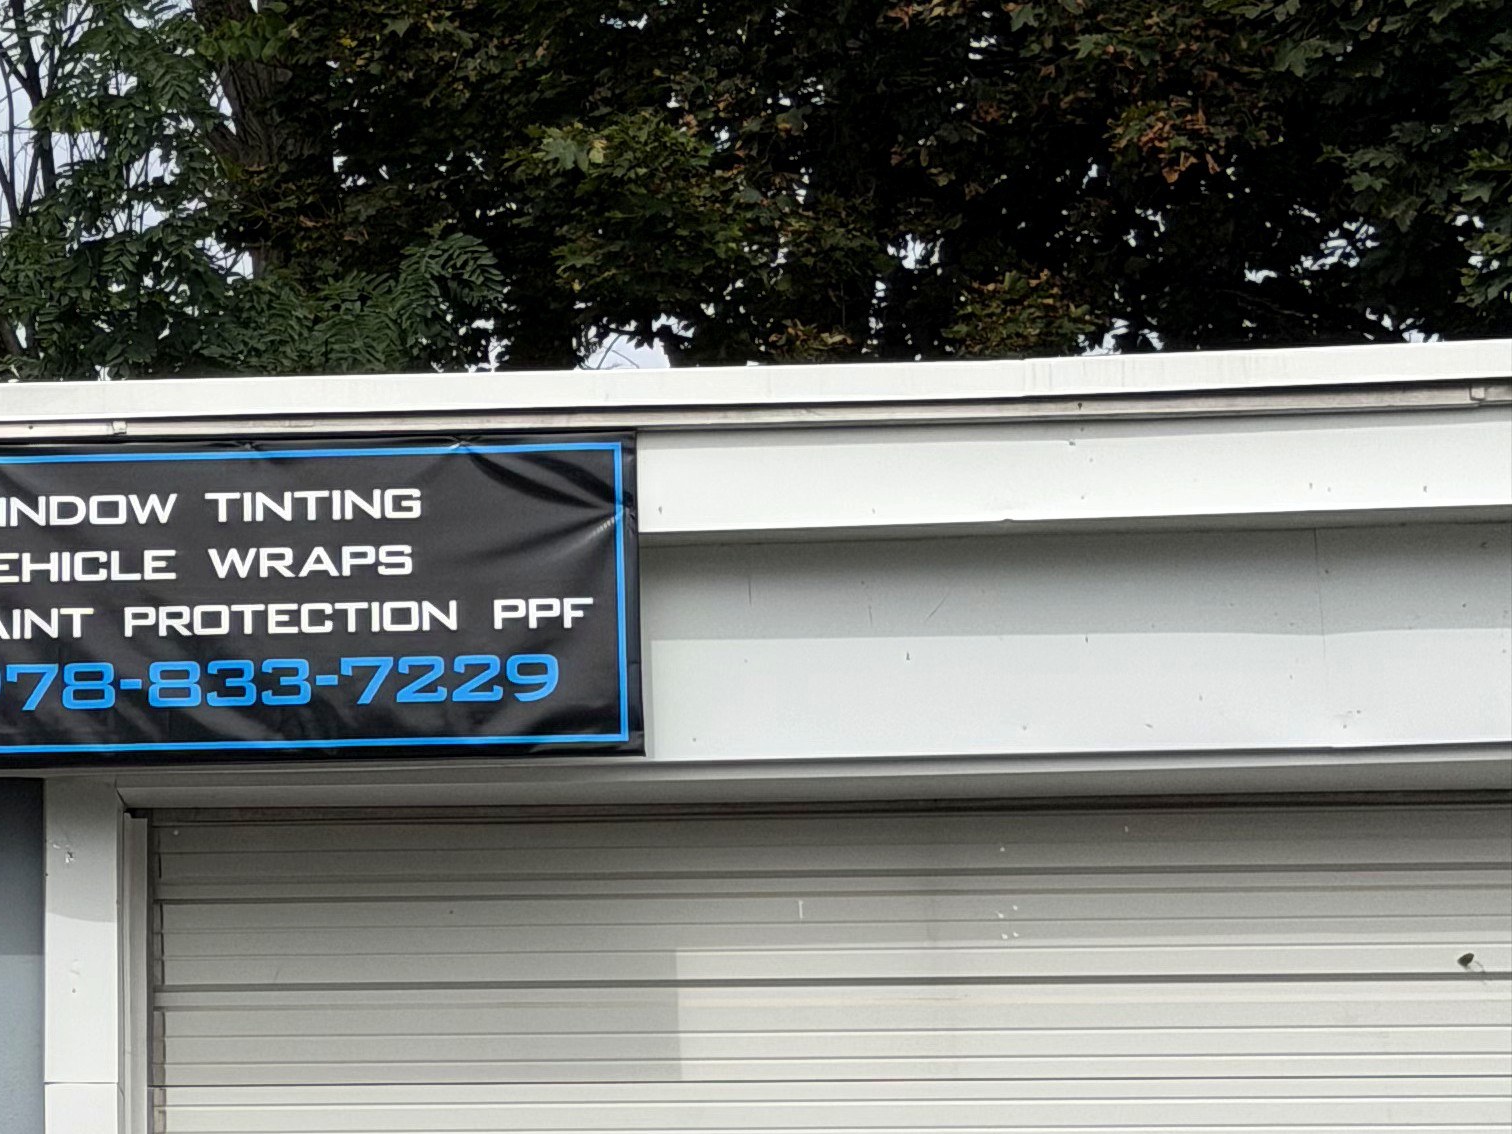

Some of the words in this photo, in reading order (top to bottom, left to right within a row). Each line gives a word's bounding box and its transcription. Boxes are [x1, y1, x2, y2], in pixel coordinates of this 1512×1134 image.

[204, 488, 421, 523] TINTING
[208, 545, 412, 578] WRAPS
[124, 600, 458, 638] PROTECTION
[493, 597, 594, 630] PPF
